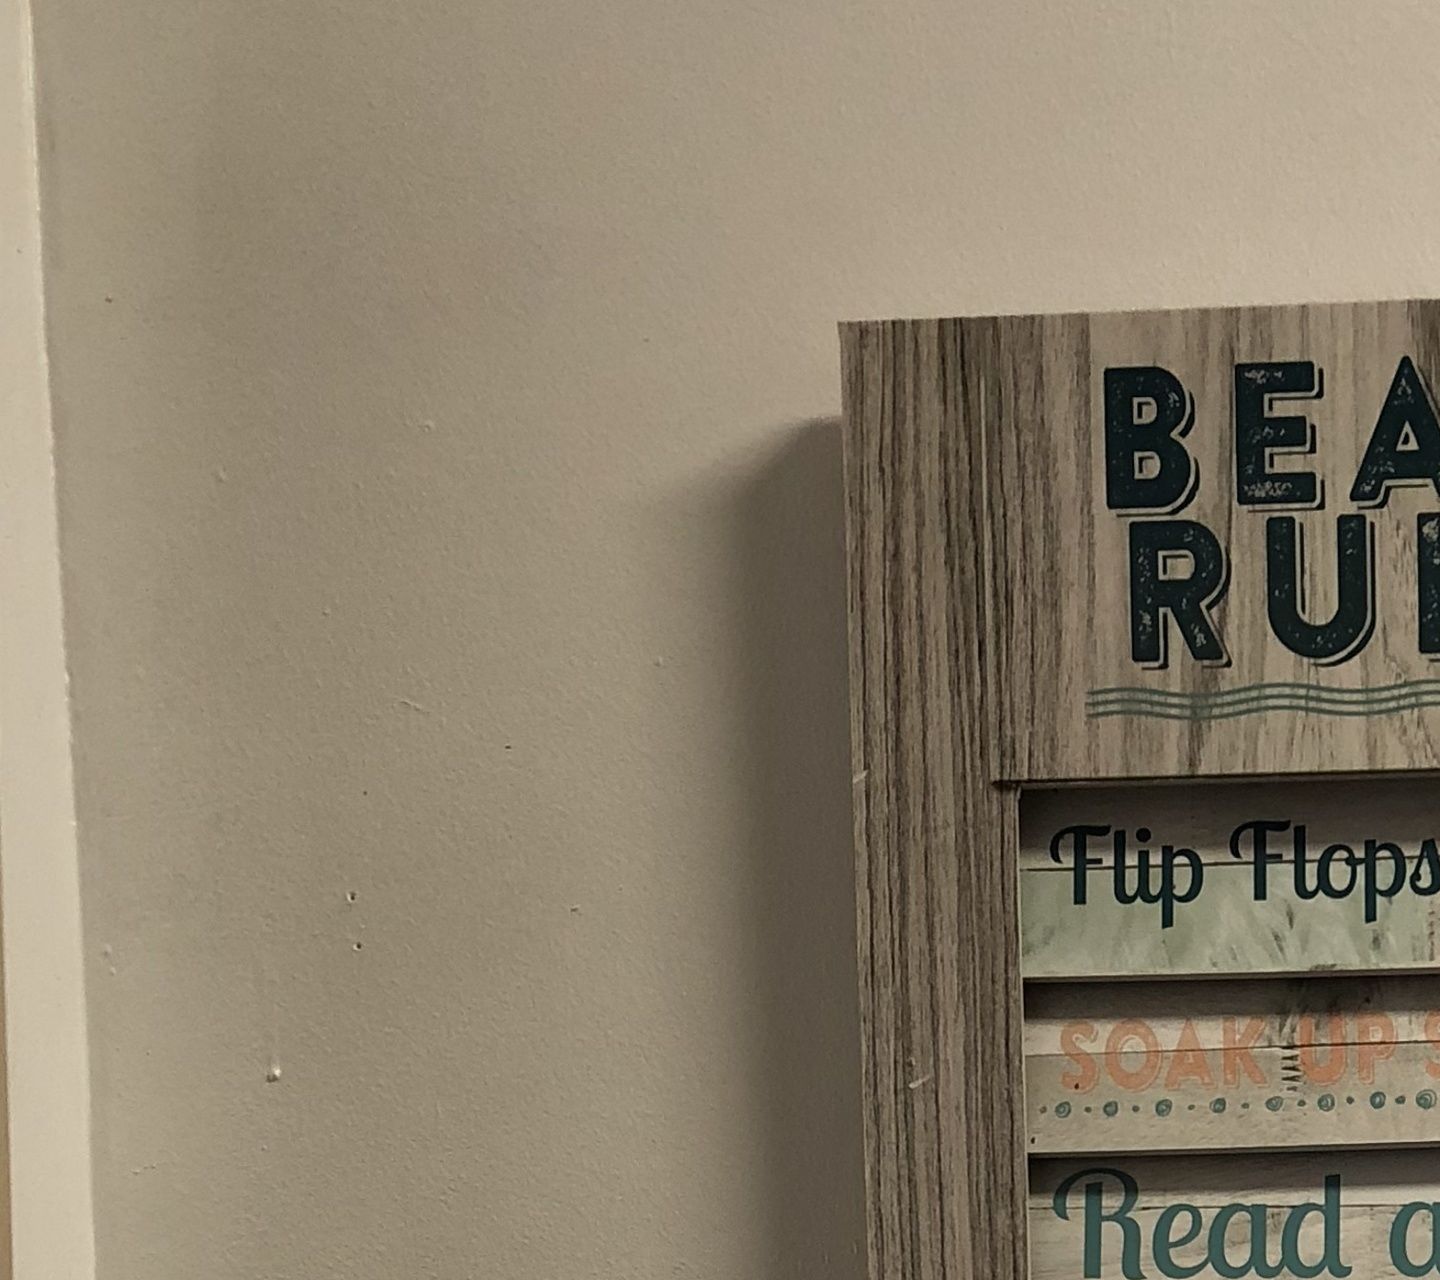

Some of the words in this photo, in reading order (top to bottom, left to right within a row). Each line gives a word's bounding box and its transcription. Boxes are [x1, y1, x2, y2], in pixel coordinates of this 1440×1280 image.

[1049, 824, 1204, 928] Flip
[1059, 1012, 1273, 1094] SOAK
[1292, 1009, 1399, 1085] UP
